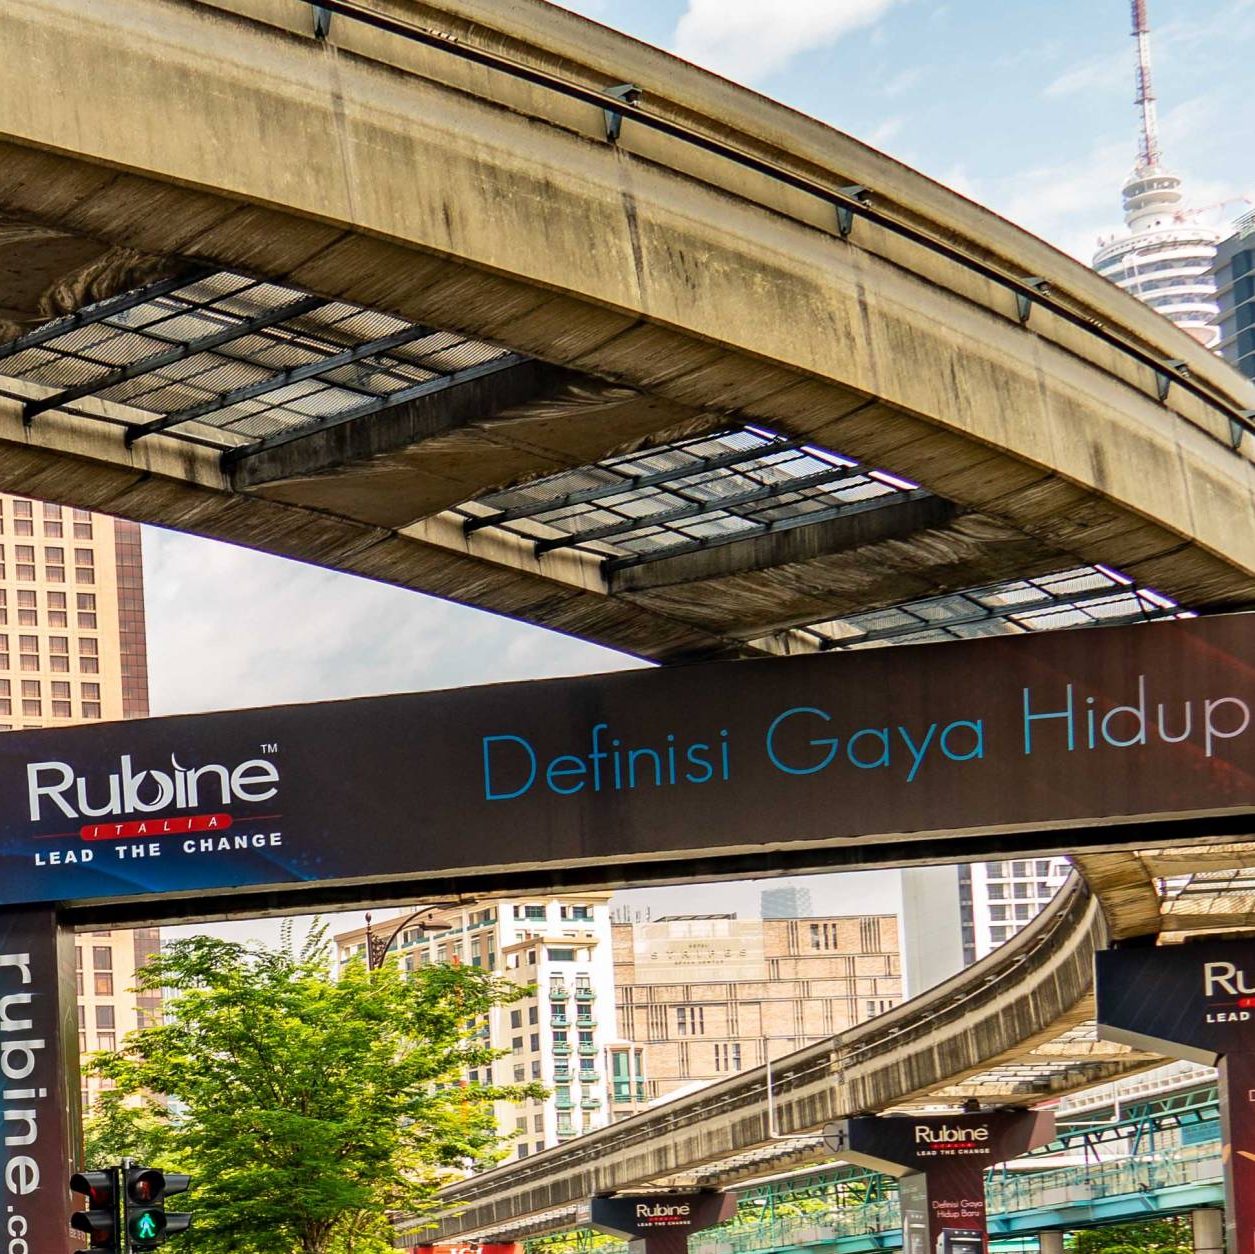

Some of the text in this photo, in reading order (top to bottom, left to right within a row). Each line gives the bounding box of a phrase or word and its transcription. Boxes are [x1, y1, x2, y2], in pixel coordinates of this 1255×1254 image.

[482, 675, 1251, 801] Definisi Gaya Hidup
[26, 752, 280, 822] Rubine
[94, 816, 218, 837] ITALIA
[34, 832, 283, 866] LEAD THE CHANGE
[1206, 1012, 1251, 1023] LEAD
[915, 1125, 989, 1143] Rubine
[636, 1203, 690, 1218] Rubine
